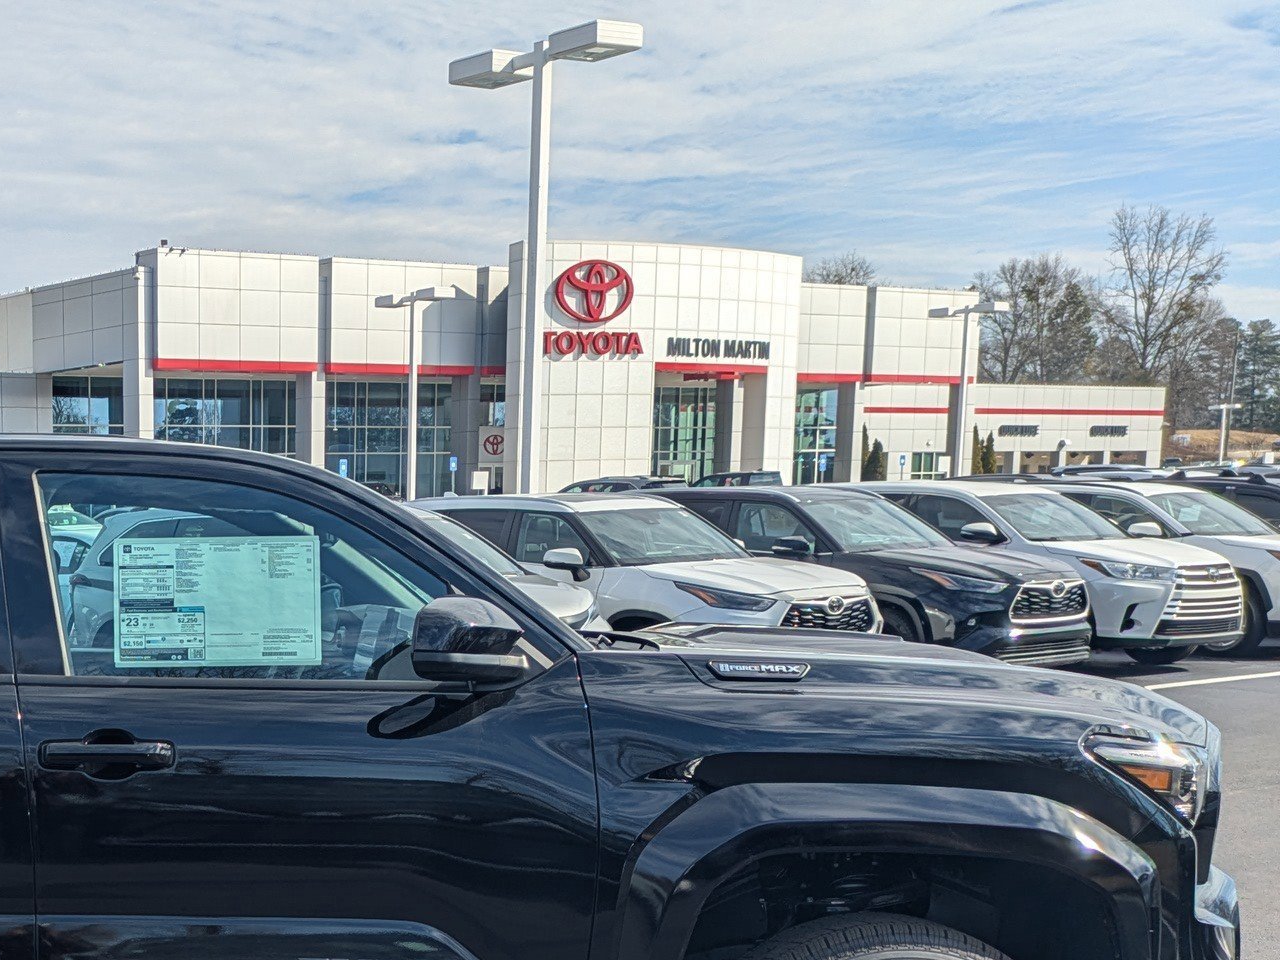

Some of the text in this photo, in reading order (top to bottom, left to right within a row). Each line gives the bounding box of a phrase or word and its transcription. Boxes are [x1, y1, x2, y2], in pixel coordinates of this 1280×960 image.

[543, 331, 644, 355] TOYOTA
[666, 337, 770, 360] MILTON MARTIN
[125, 617, 139, 627] 23
[761, 664, 800, 673] MAX
